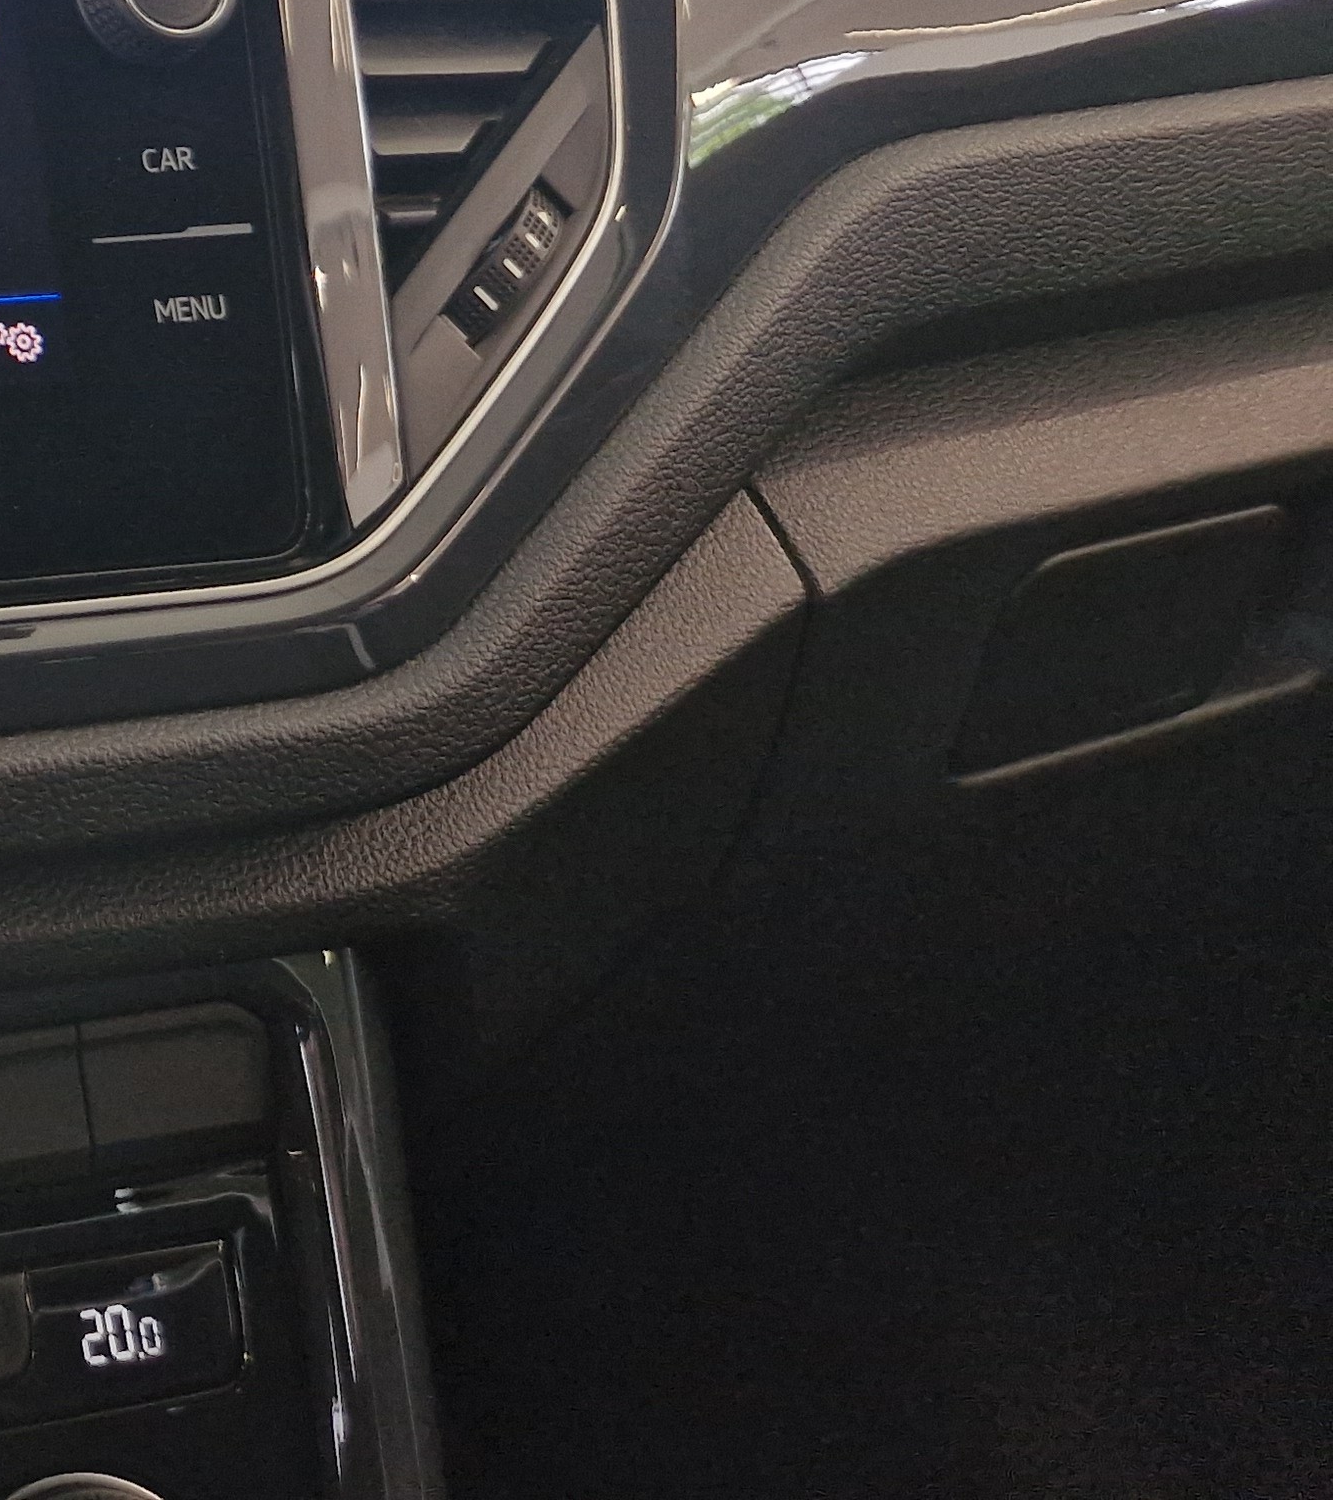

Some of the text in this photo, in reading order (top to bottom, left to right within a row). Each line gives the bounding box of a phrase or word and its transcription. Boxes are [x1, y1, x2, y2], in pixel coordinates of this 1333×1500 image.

[141, 146, 196, 173] CAR
[153, 294, 227, 323] MENU
[79, 1304, 162, 1366] 20.0
